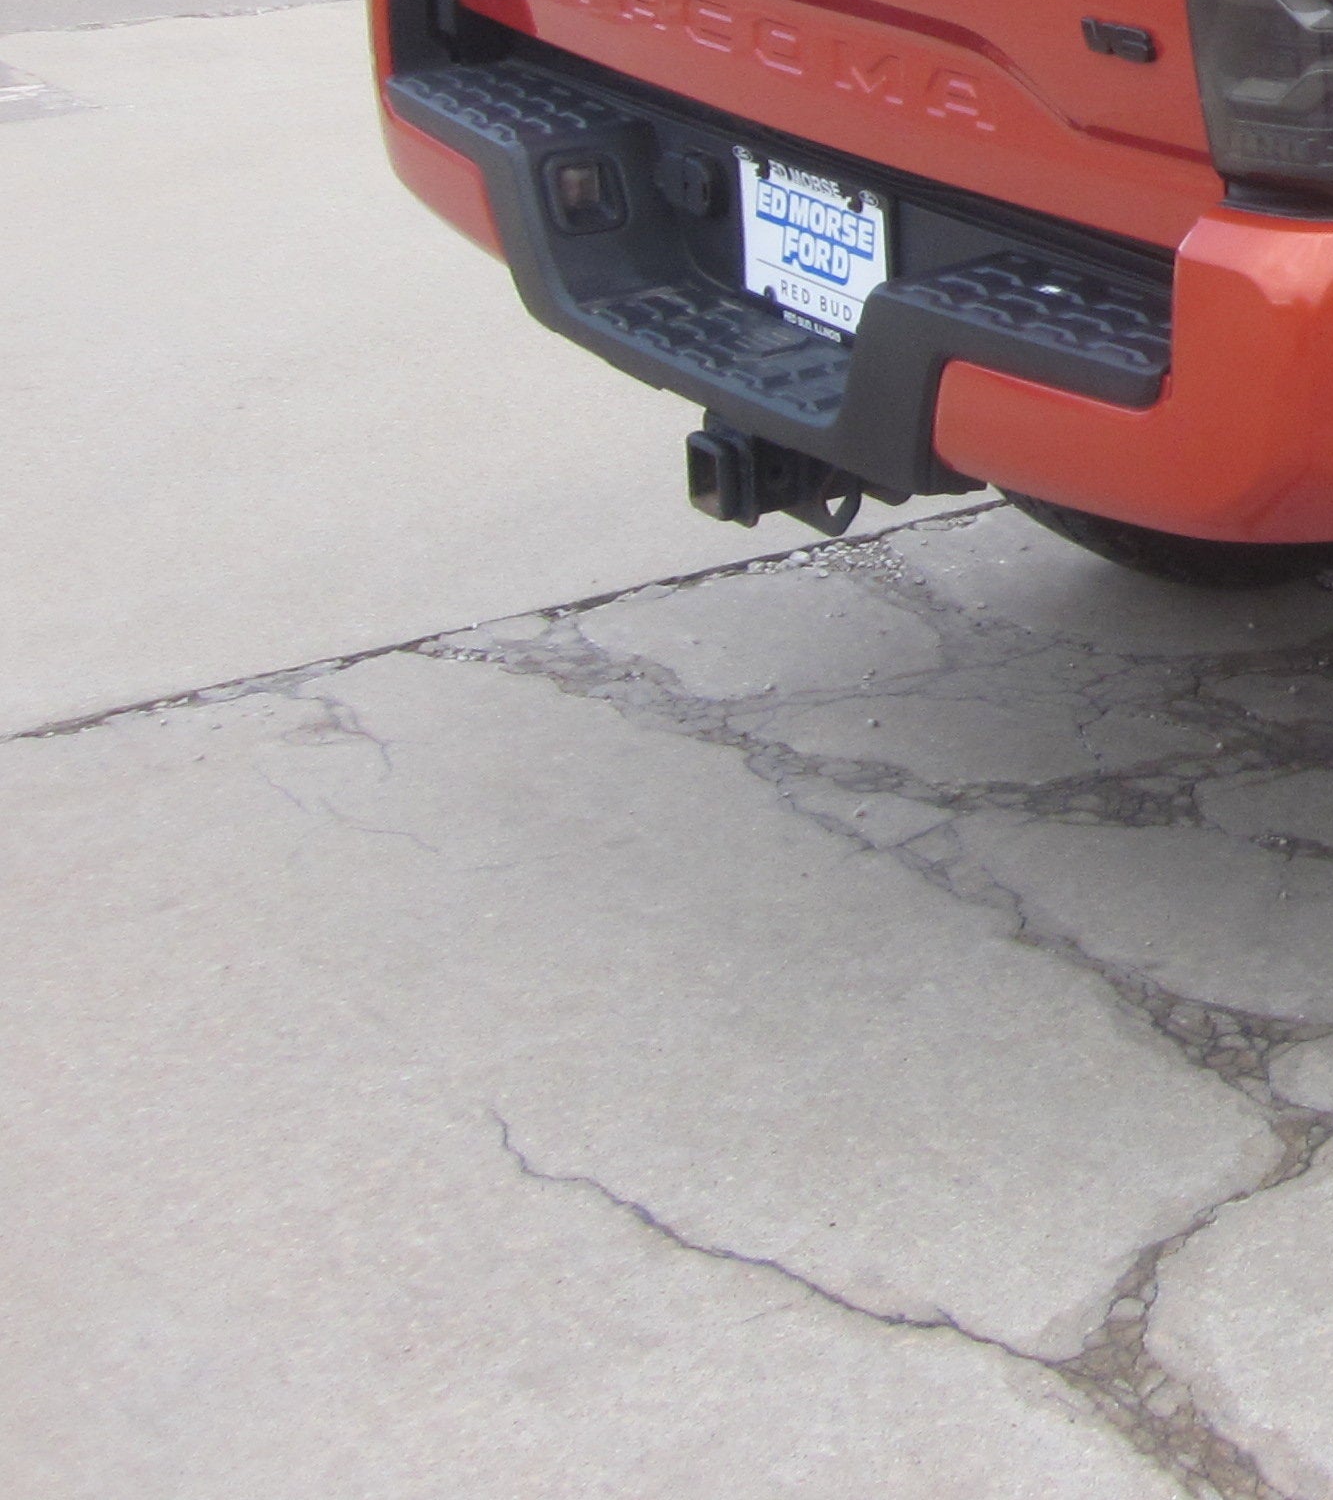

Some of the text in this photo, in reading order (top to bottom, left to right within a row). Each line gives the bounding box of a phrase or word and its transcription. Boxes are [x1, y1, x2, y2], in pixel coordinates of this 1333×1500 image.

[1080, 17, 1158, 63] V6
[757, 180, 874, 256] ED MORSE
[783, 226, 849, 283] FORD
[780, 279, 854, 322] RED BUD
